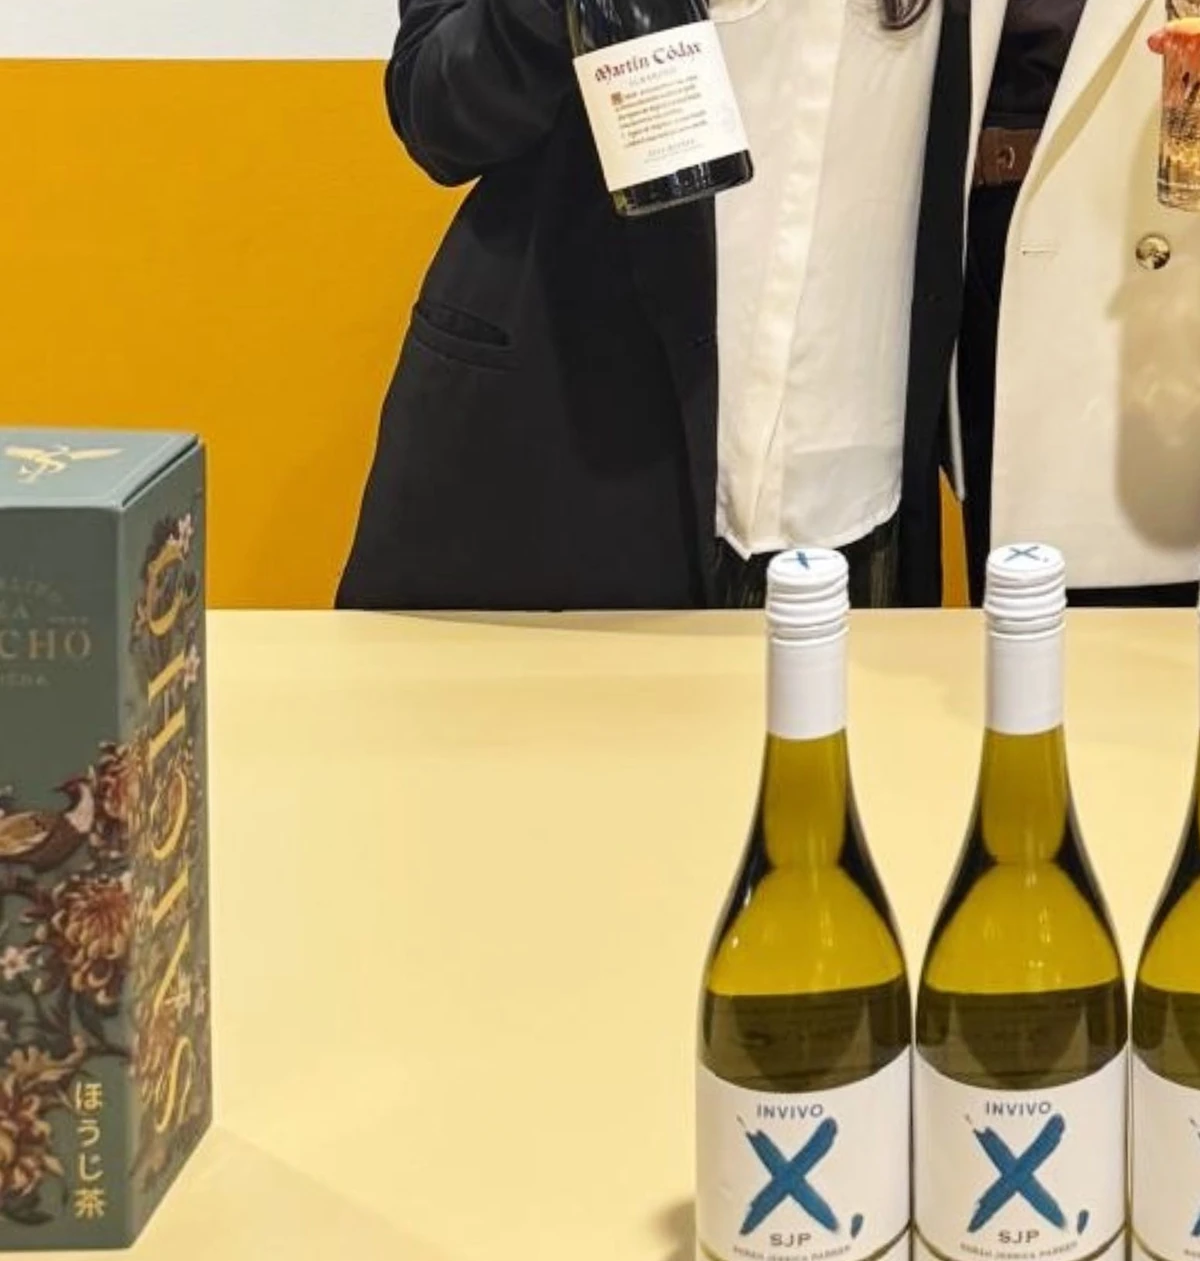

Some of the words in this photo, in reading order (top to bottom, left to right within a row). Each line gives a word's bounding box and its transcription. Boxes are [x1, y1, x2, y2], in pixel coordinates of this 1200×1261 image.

[757, 1103, 824, 1120] INVIVO
[986, 1101, 1052, 1116] INVIVO
[75, 1081, 104, 1218] ほうじ茶
[770, 1232, 812, 1247] SJP
[998, 1229, 1040, 1244] SJP
